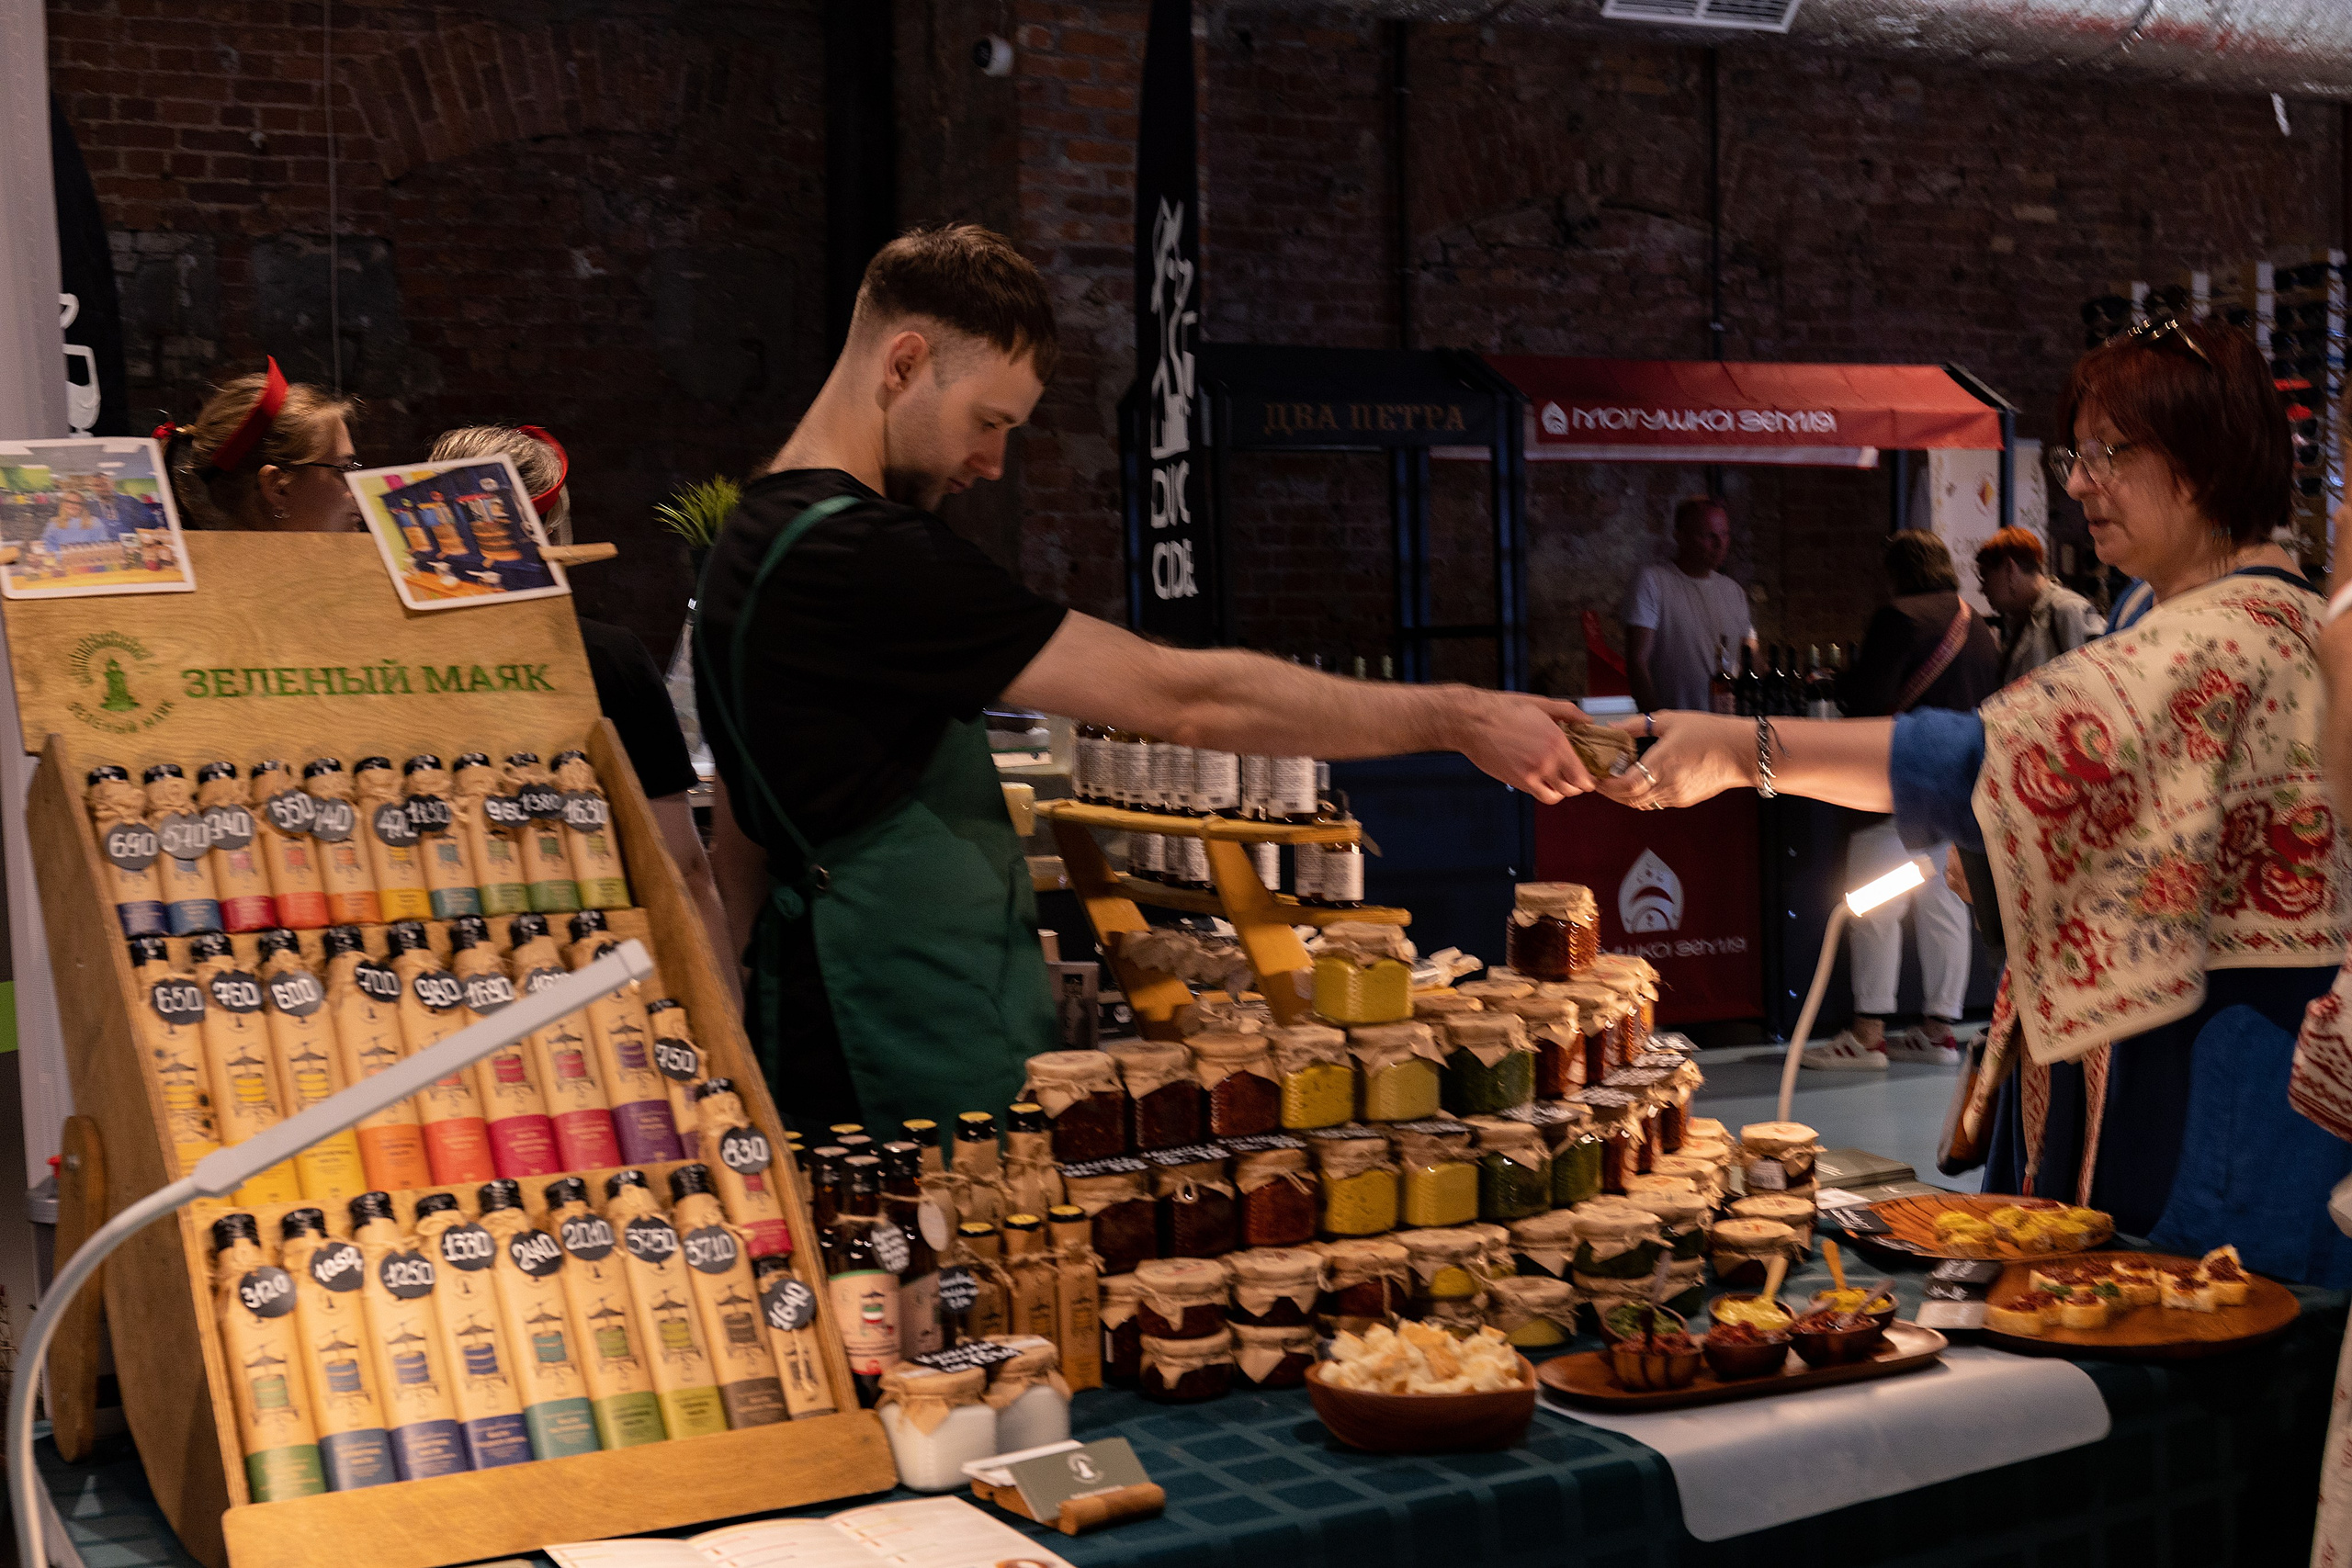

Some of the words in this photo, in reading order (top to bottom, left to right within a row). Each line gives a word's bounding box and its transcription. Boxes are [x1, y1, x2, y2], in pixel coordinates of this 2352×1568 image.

[181, 658, 413, 699] ЗЕЛЕНЫЙ
[420, 663, 556, 695] МАЯК
[211, 980, 263, 1008] 760
[270, 976, 318, 1010] 600
[355, 966, 401, 996] 700
[154, 985, 205, 1013] 650
[721, 1135, 770, 1168] 830
